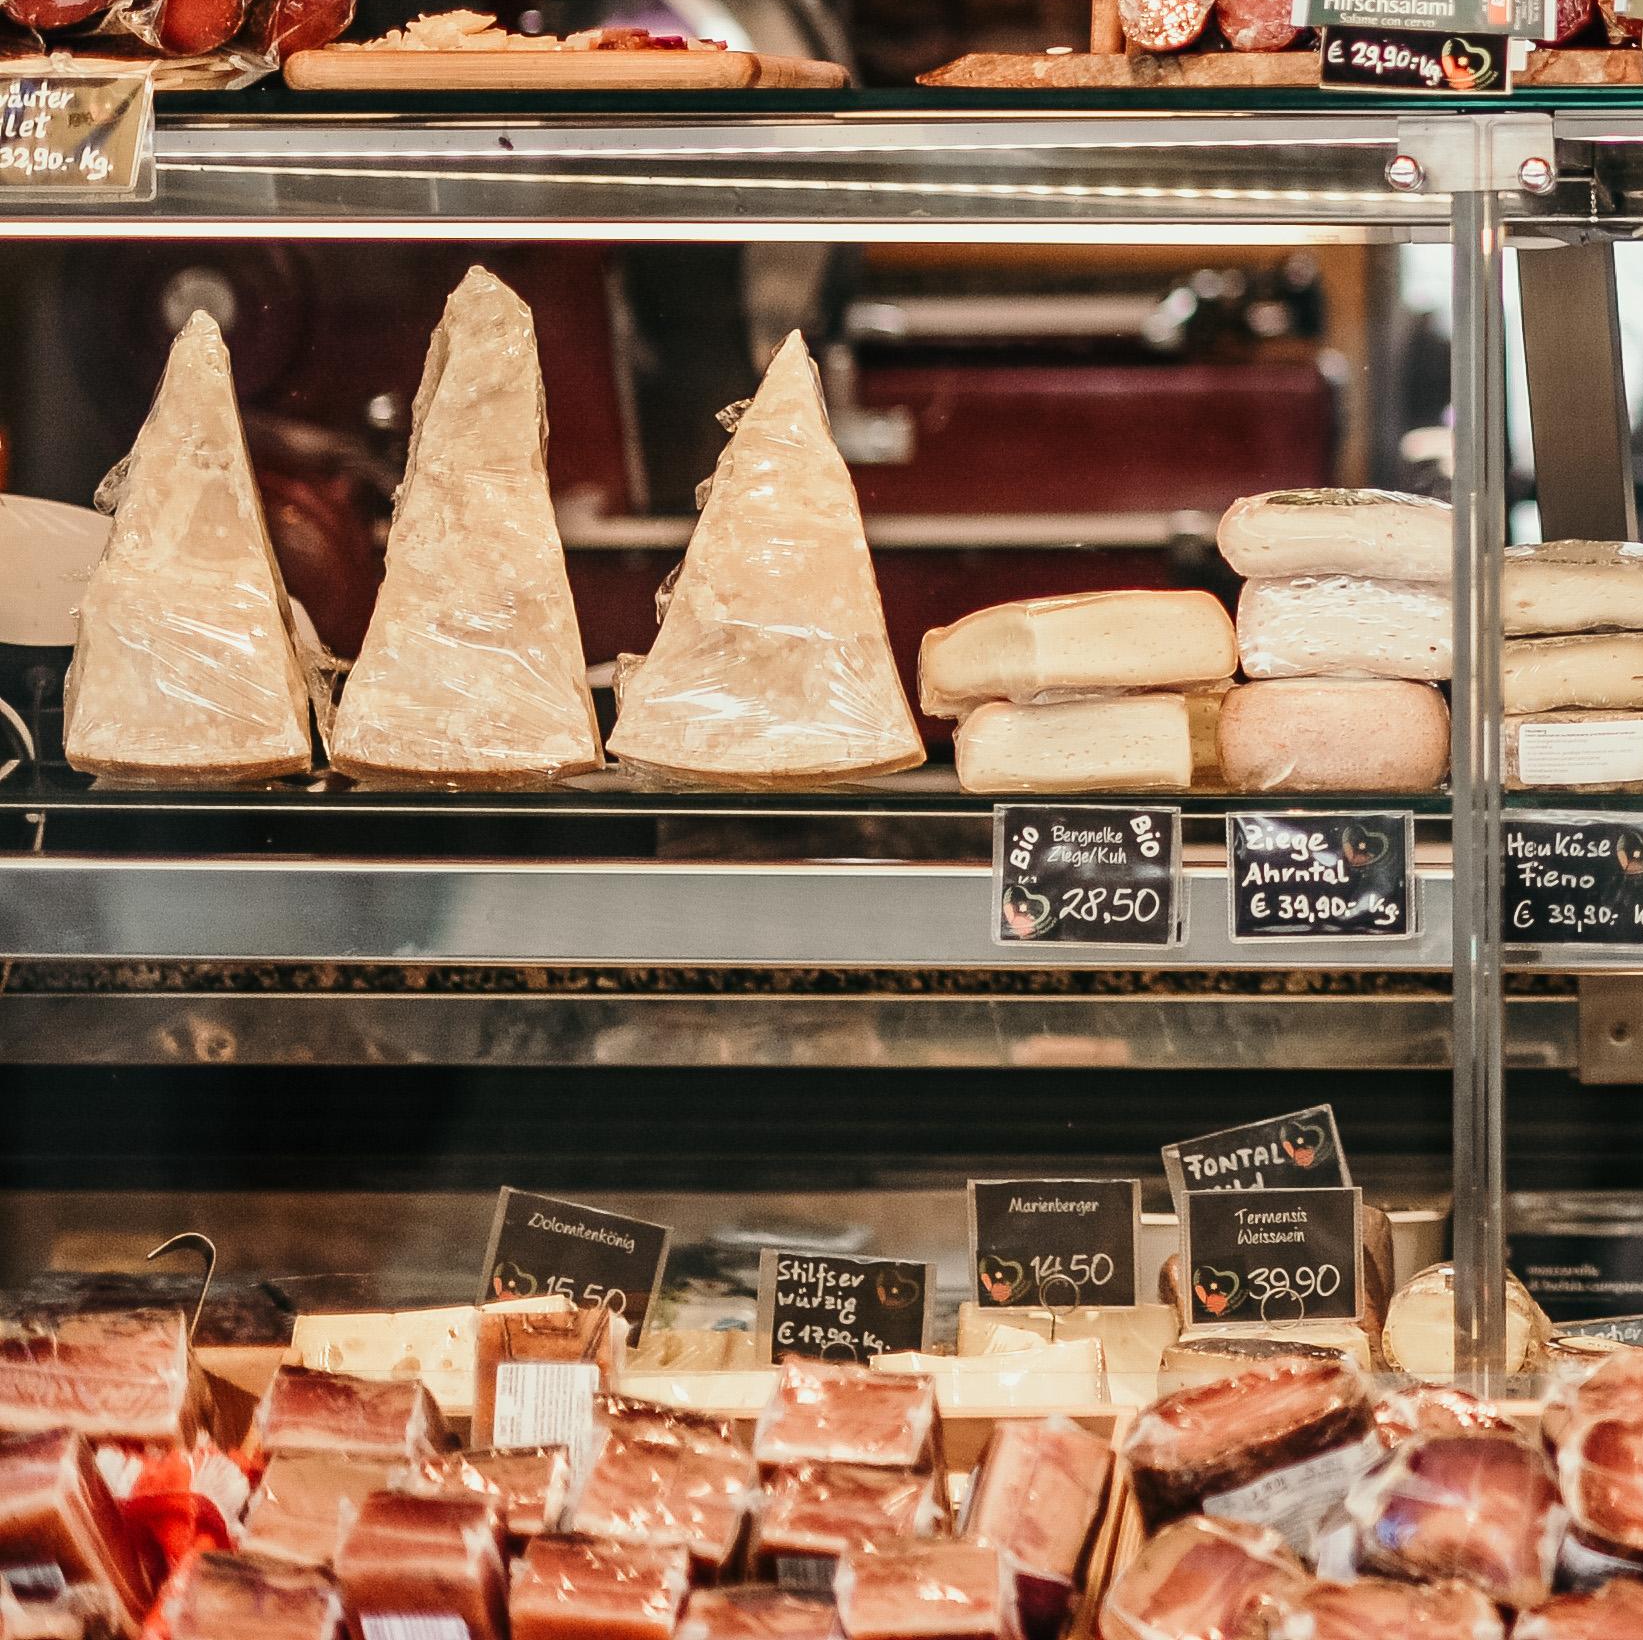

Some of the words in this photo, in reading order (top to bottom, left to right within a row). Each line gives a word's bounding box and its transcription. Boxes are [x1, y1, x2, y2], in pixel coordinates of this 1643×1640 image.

[1340, 13, 1378, 25] Salame
[1381, 16, 1401, 26] con
[1010, 825, 1040, 869] Bio
[1051, 826, 1124, 848] Bergnelke
[1129, 813, 1161, 859] Bio
[1246, 825, 1328, 861] Ziege
[1047, 845, 1128, 866] Ziege/Kuh
[1242, 861, 1349, 886] Ahrntal
[1518, 863, 1595, 889] Fieno
[1058, 887, 1160, 924] 28,50
[1183, 1143, 1286, 1181] FONTAL
[1007, 1196, 1100, 1216] Marienberger
[1234, 1206, 1308, 1225] Termensis
[527, 1212, 636, 1254] Dolomitenkönig
[1236, 1227, 1306, 1246] Weisswein
[777, 1260, 865, 1298] Stilfser
